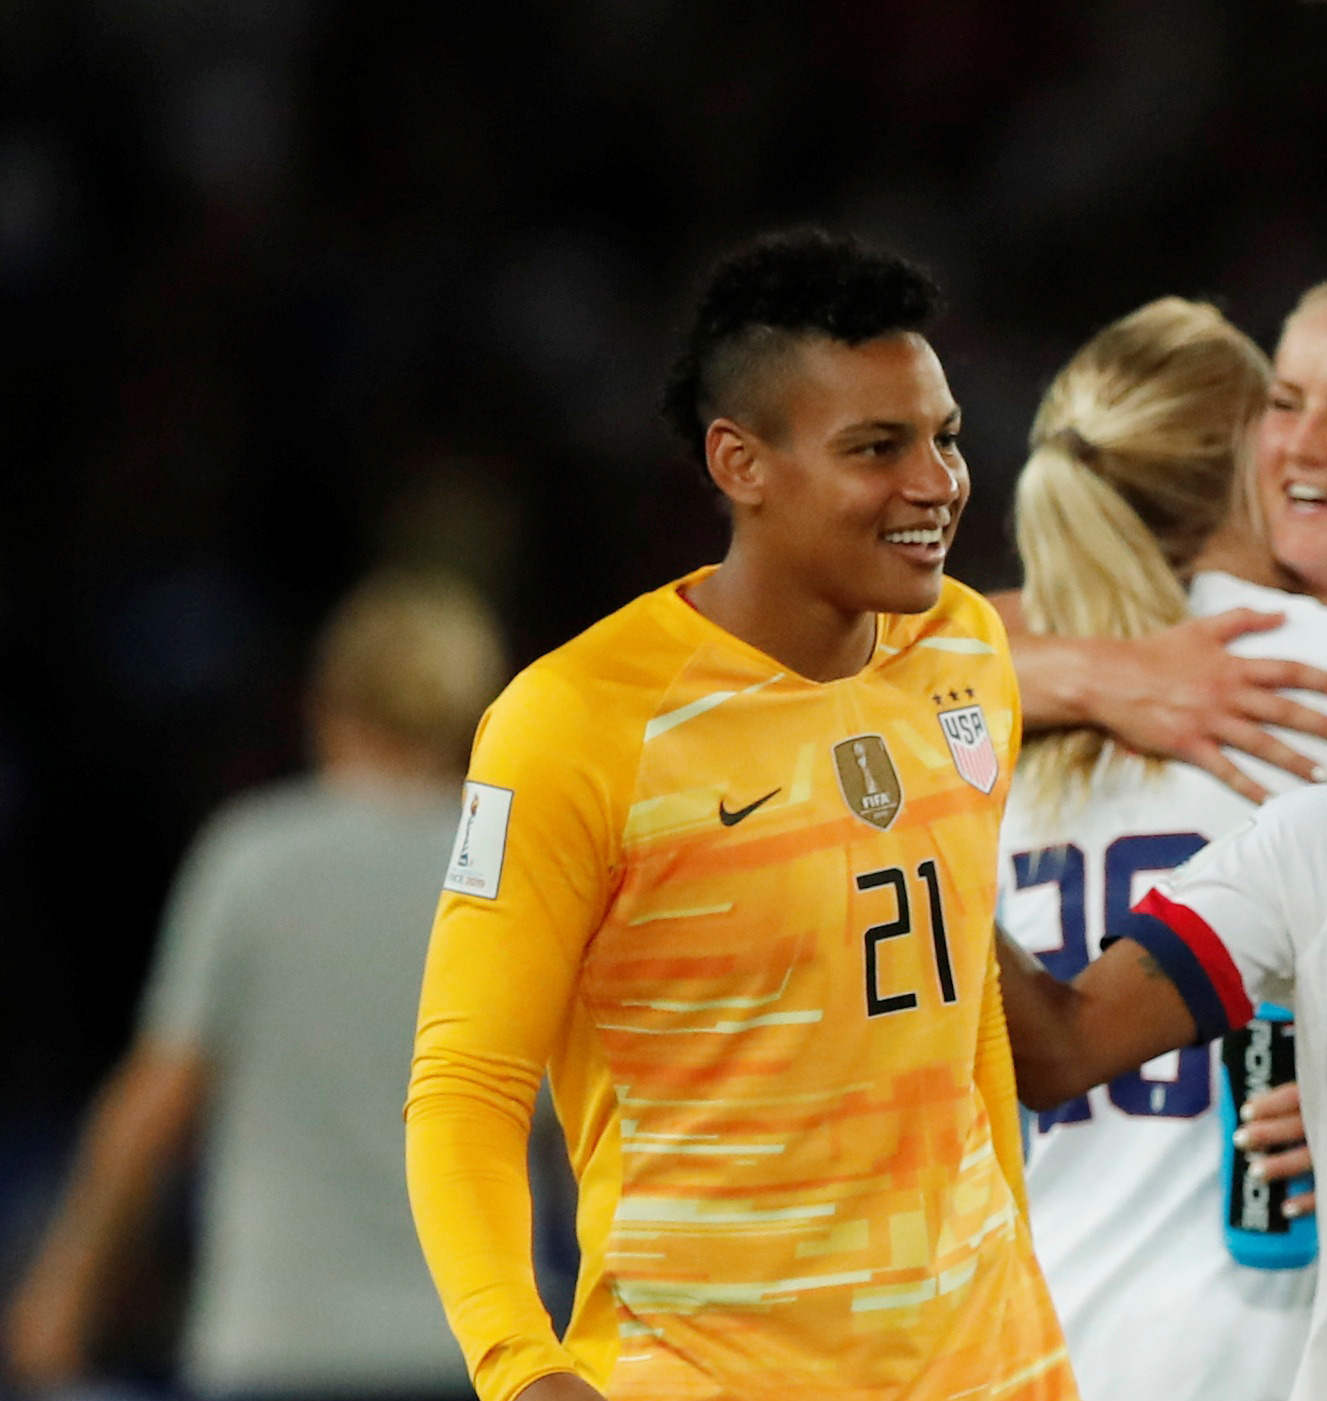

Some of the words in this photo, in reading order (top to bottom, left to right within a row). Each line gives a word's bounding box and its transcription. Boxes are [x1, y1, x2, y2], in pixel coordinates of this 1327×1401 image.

[944, 712, 984, 745] USA
[862, 792, 889, 808] FIFA
[856, 860, 957, 1017] 21
